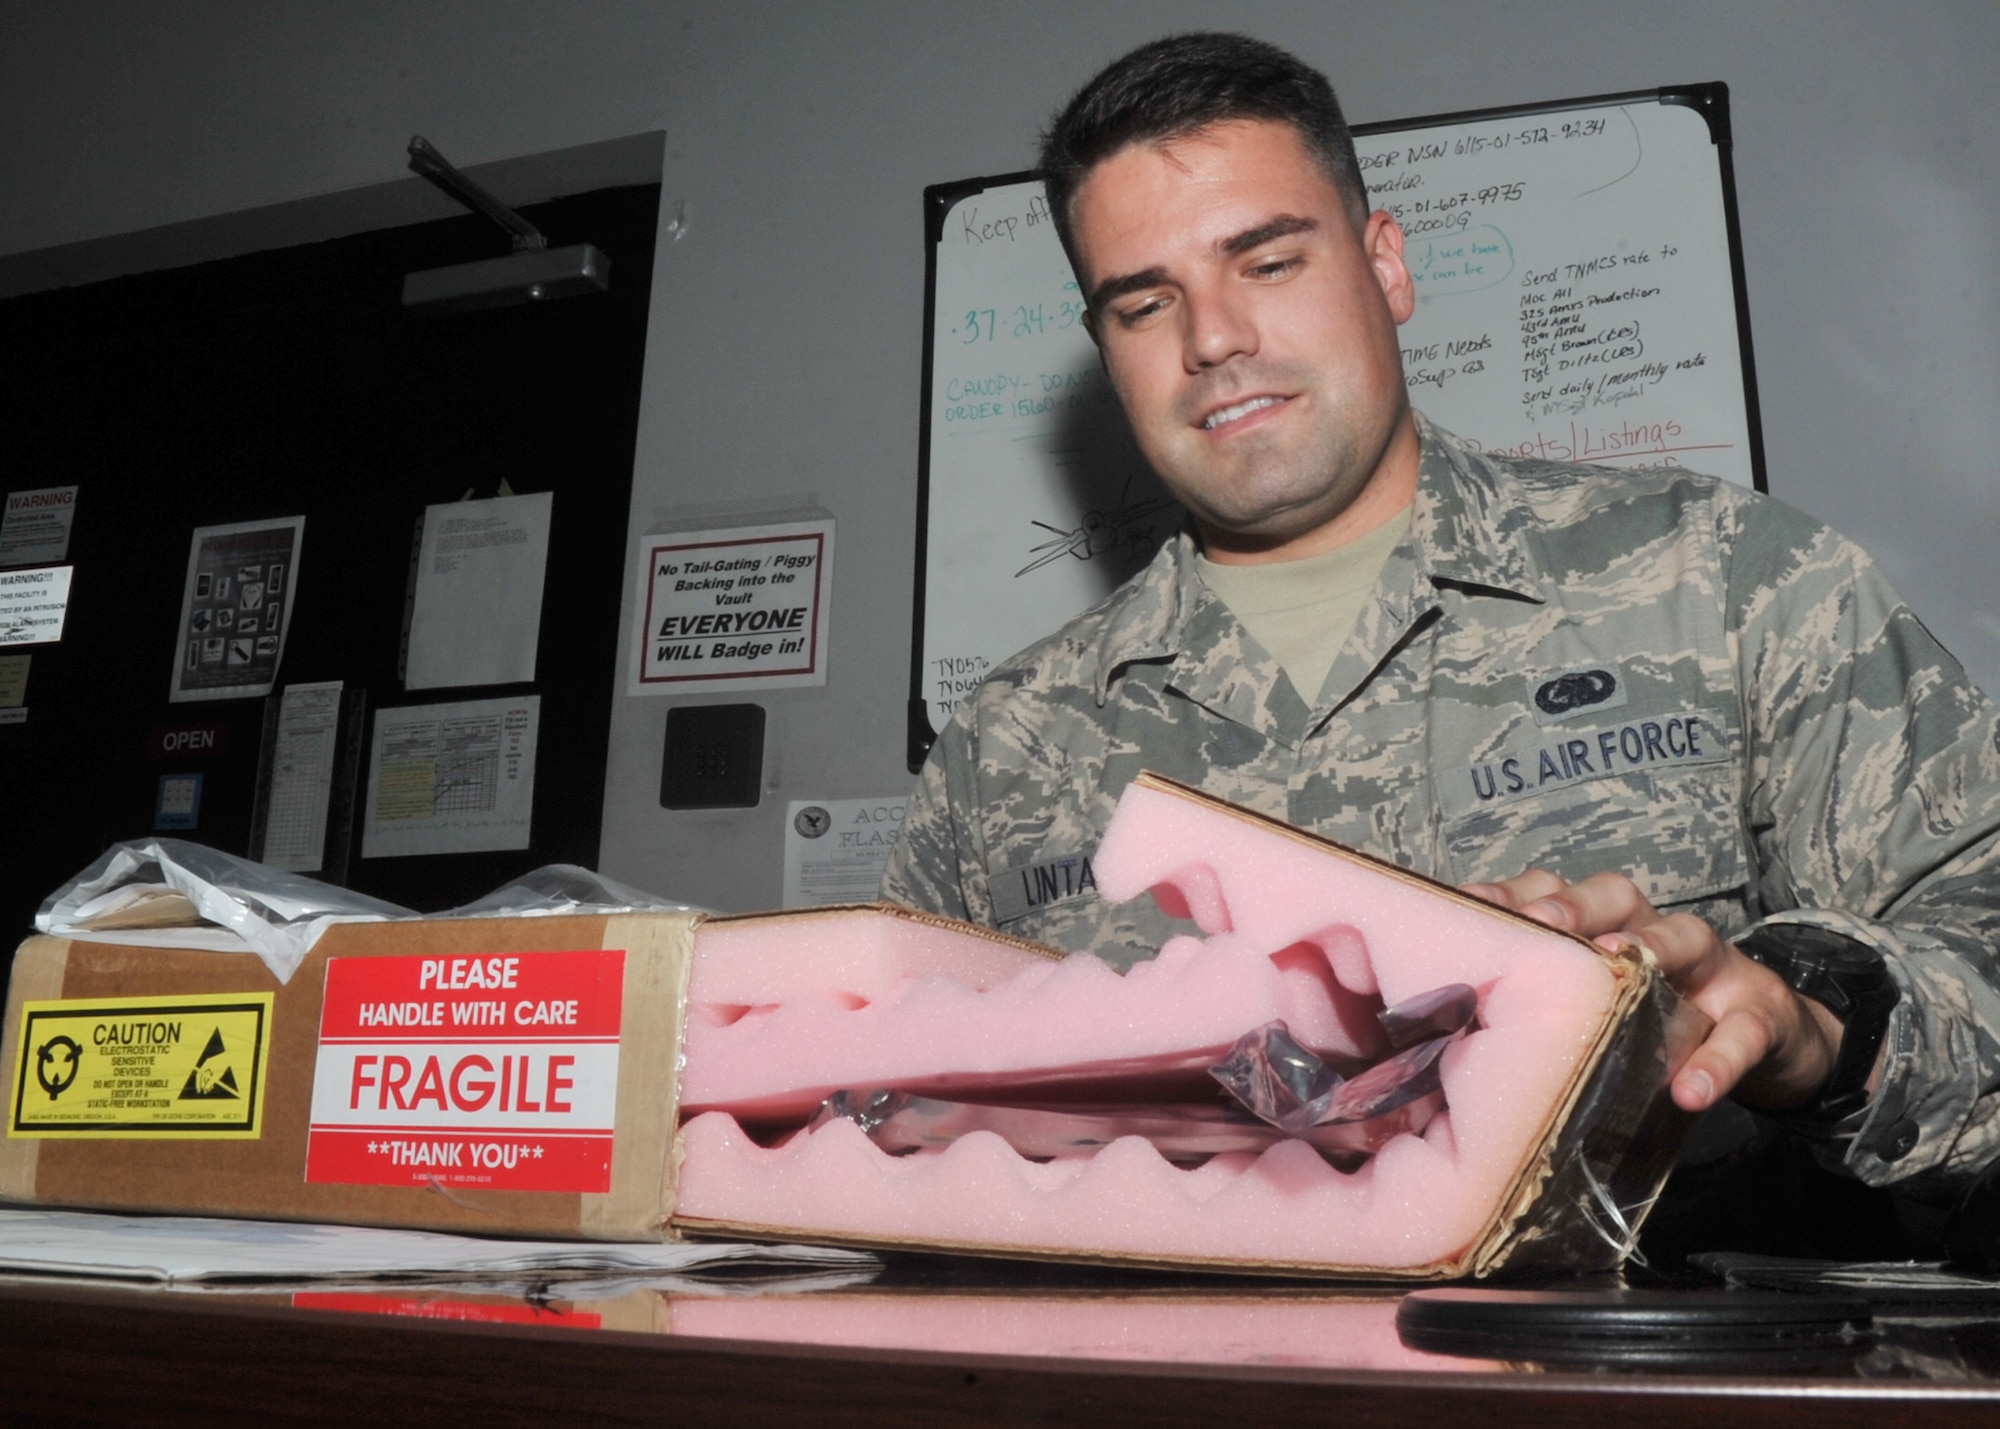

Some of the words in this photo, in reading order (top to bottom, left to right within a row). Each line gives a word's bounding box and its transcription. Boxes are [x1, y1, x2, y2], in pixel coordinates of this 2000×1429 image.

[962, 208, 1018, 243] Keep
[1521, 270, 1557, 287] Send
[1623, 250, 1650, 265] rate
[1660, 244, 1678, 259] to
[1522, 386, 1552, 405] Send
[945, 402, 1003, 421] ORDER
[9, 491, 73, 510] WARNING
[658, 564, 678, 576] No
[682, 558, 761, 575] Tail-Gating
[774, 554, 816, 568] Piggy
[0, 572, 53, 585] WARNING!!!
[674, 577, 734, 592] Backing
[738, 575, 766, 588] into
[771, 573, 795, 584] the
[33, 602, 65, 610] INTRUSION
[715, 593, 753, 606] Vault
[658, 607, 807, 637] EVERYONE
[656, 645, 704, 662] WILL
[711, 641, 773, 661] Badge
[778, 637, 805, 654] in!
[162, 729, 215, 751] OPEN
[1471, 758, 1533, 801] U.S.
[1539, 739, 1595, 786] AIR
[1598, 716, 1703, 770] FORCE
[1021, 856, 1098, 906] LINTA
[419, 958, 519, 990] PLEASE
[358, 1002, 445, 1026] HANDLE
[451, 1001, 506, 1026] WITH
[514, 1000, 579, 1026] CARE
[93, 1022, 181, 1045] CAUTION
[100, 1045, 170, 1055] ELECTROSTATIC
[111, 1056, 155, 1066] SENSITIVE
[113, 1067, 151, 1076] DEVICES
[93, 1080, 102, 1088] DO
[103, 1080, 115, 1088] NOT
[117, 1080, 132, 1088] OPEN
[134, 1079, 143, 1088] OR
[145, 1079, 169, 1087] HANDLE
[350, 1054, 575, 1112] FRAGILE
[87, 1100, 124, 1108] STATIC-FREE
[127, 1099, 170, 1108] WORKSTATION
[111, 1090, 133, 1098] EXCEPT
